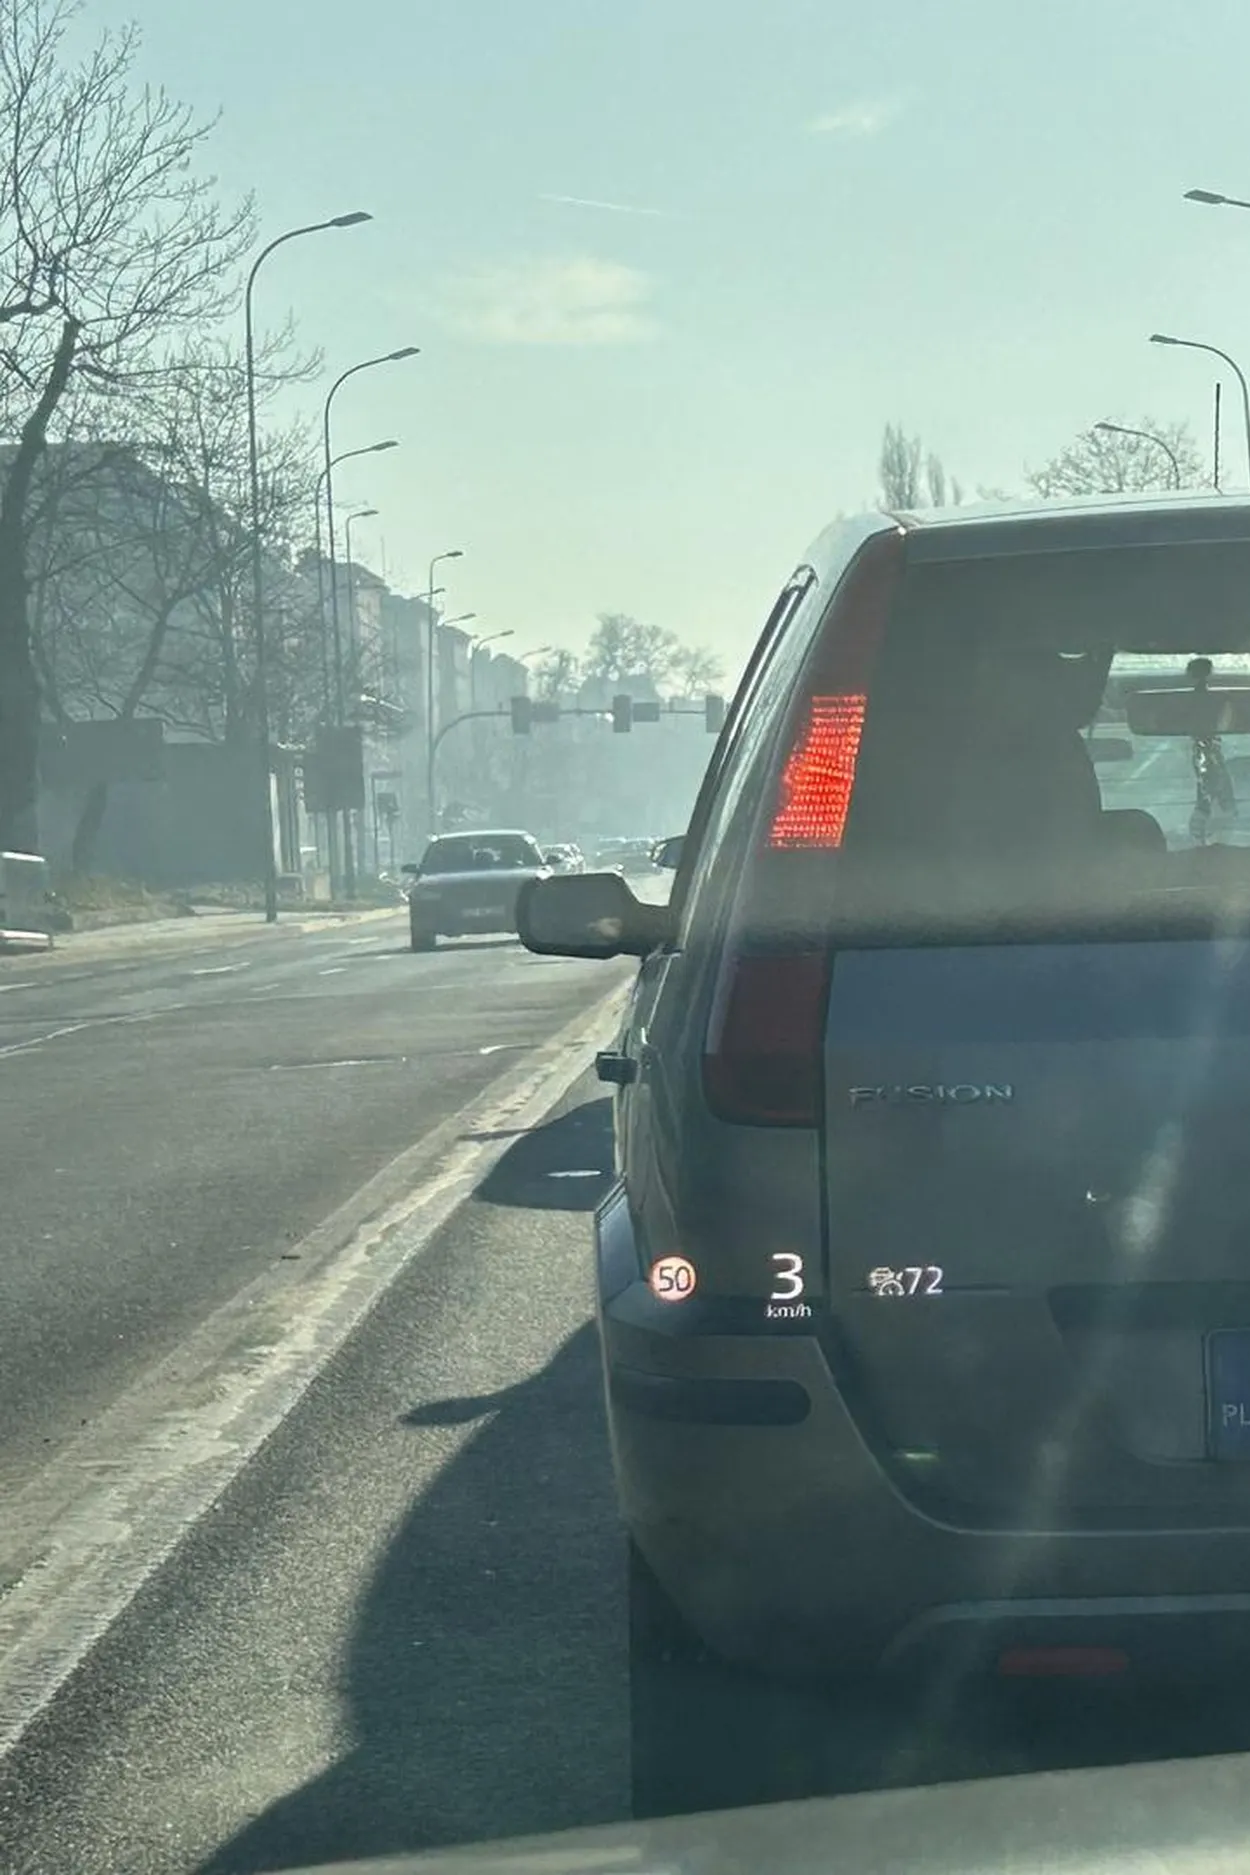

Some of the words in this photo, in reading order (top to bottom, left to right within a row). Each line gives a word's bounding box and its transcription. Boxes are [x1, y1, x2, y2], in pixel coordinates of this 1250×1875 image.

[658, 1266, 692, 1291] 50
[770, 1253, 804, 1300] 3
[904, 1267, 943, 1295] 72
[765, 1304, 812, 1318] km/h
